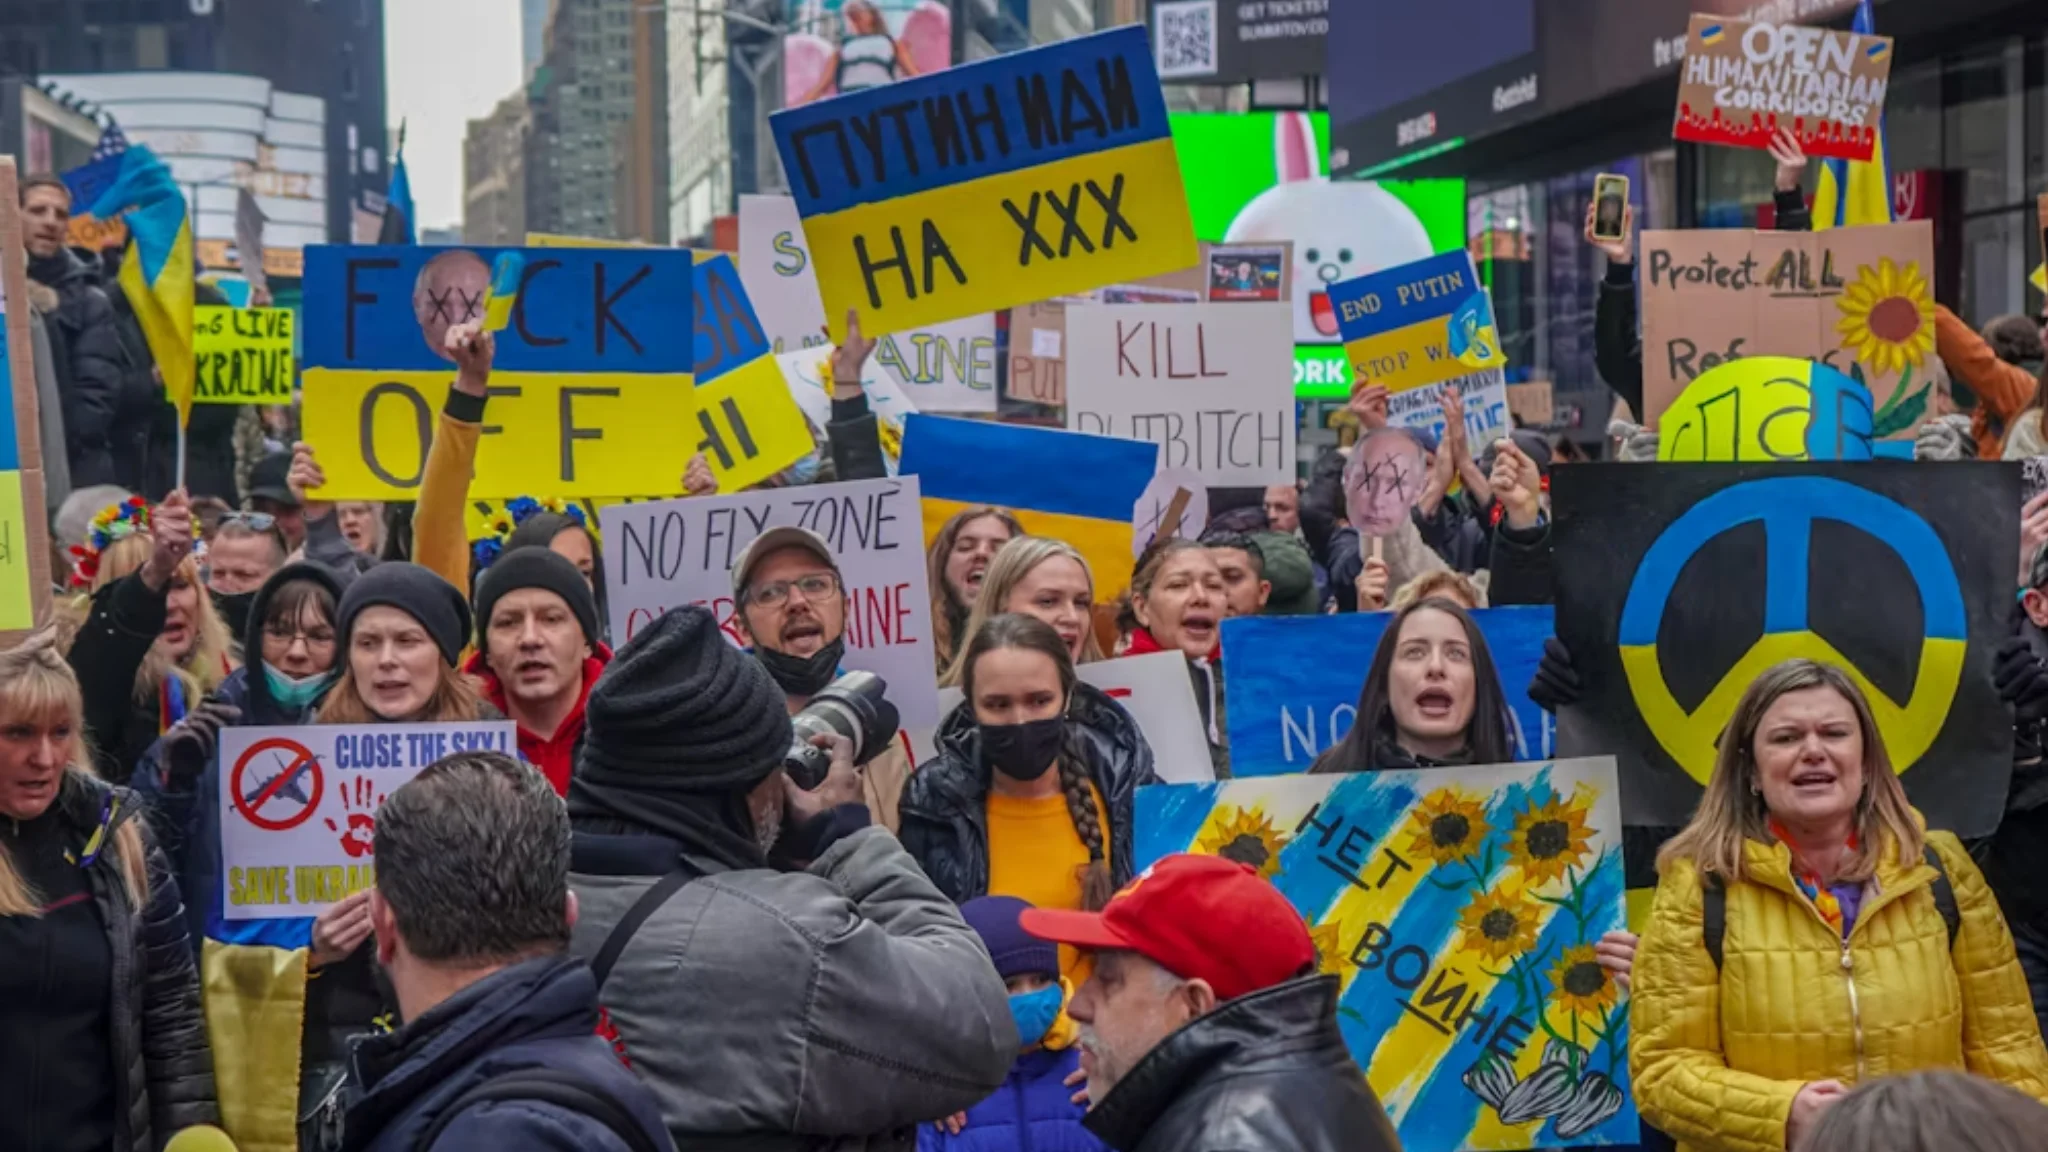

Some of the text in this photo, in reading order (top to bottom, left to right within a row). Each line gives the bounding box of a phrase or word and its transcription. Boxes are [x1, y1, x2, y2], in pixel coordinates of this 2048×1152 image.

[1742, 22, 1860, 76] OPEN
[1686, 55, 1887, 107] HUMANITARIAN
[1714, 85, 1868, 126] CORRIDORS
[791, 84, 1011, 199] ПУТИН
[1340, 271, 1464, 323] END PUTIN
[1649, 248, 1843, 294] Protect ALL
[233, 309, 290, 337] LIVE
[344, 257, 653, 361] FCK
[194, 347, 291, 398] KRAINE
[1117, 320, 1228, 378] KILL
[1356, 350, 1410, 380] STOP
[622, 511, 686, 584] NO
[703, 504, 772, 571] FLY
[791, 489, 900, 553] ZONE
[627, 597, 746, 647] OR
[335, 733, 401, 769] CLOSE
[407, 732, 446, 768] THE
[1295, 802, 1412, 890] НЕТ
[229, 863, 372, 906] SAVE UKRAI
[1350, 921, 1534, 1062] ВОЙНЕ
